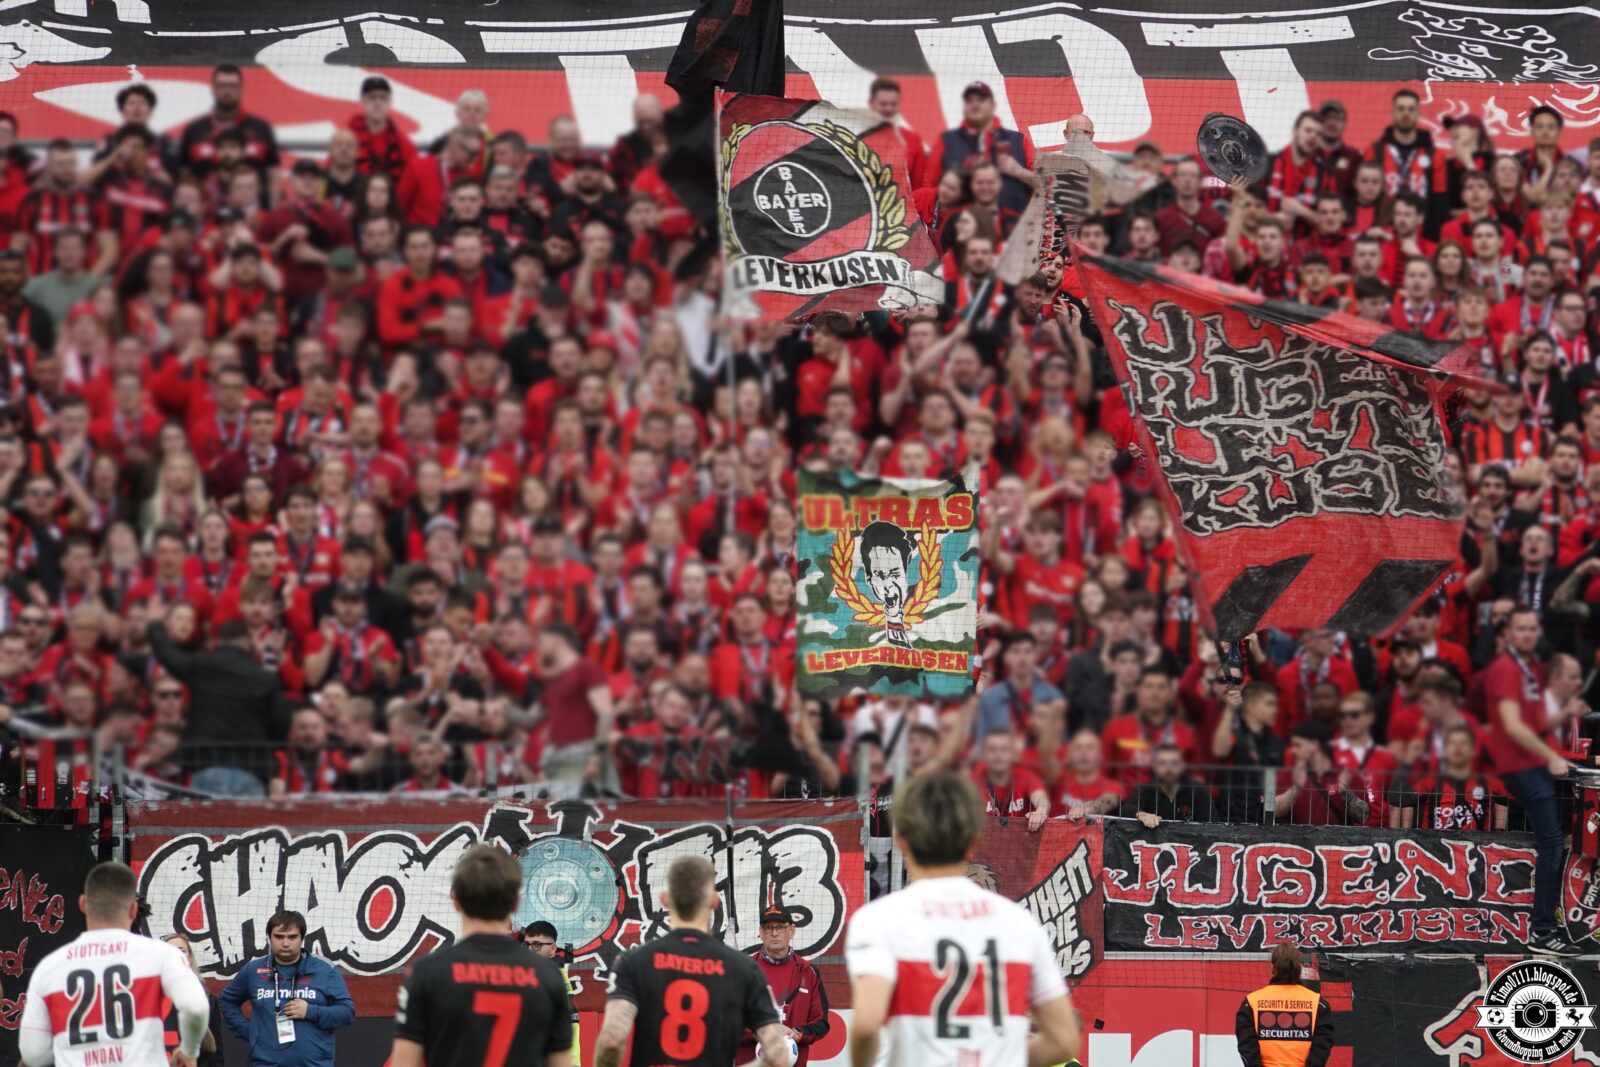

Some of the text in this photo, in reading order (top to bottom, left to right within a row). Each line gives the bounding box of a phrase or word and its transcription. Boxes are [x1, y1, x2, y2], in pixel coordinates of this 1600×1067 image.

[757, 193, 827, 210] BAYER
[732, 254, 899, 291] LEVERKUSEN
[802, 492, 974, 533] ULTRAS
[805, 645, 970, 674] LEVERKUSEN
[1144, 907, 1532, 950] LEVERKUSEN
[66, 941, 129, 960] STUTTGART
[66, 964, 135, 1046] 26
[934, 938, 1004, 1039] 21
[1258, 999, 1284, 1009] SECURITY
[1290, 1000, 1313, 1010] SERVICE
[473, 991, 523, 1067] 7
[660, 979, 710, 1060] 8
[1260, 1029, 1310, 1038] SECURITAS
[84, 1046, 123, 1067] UNDAV
